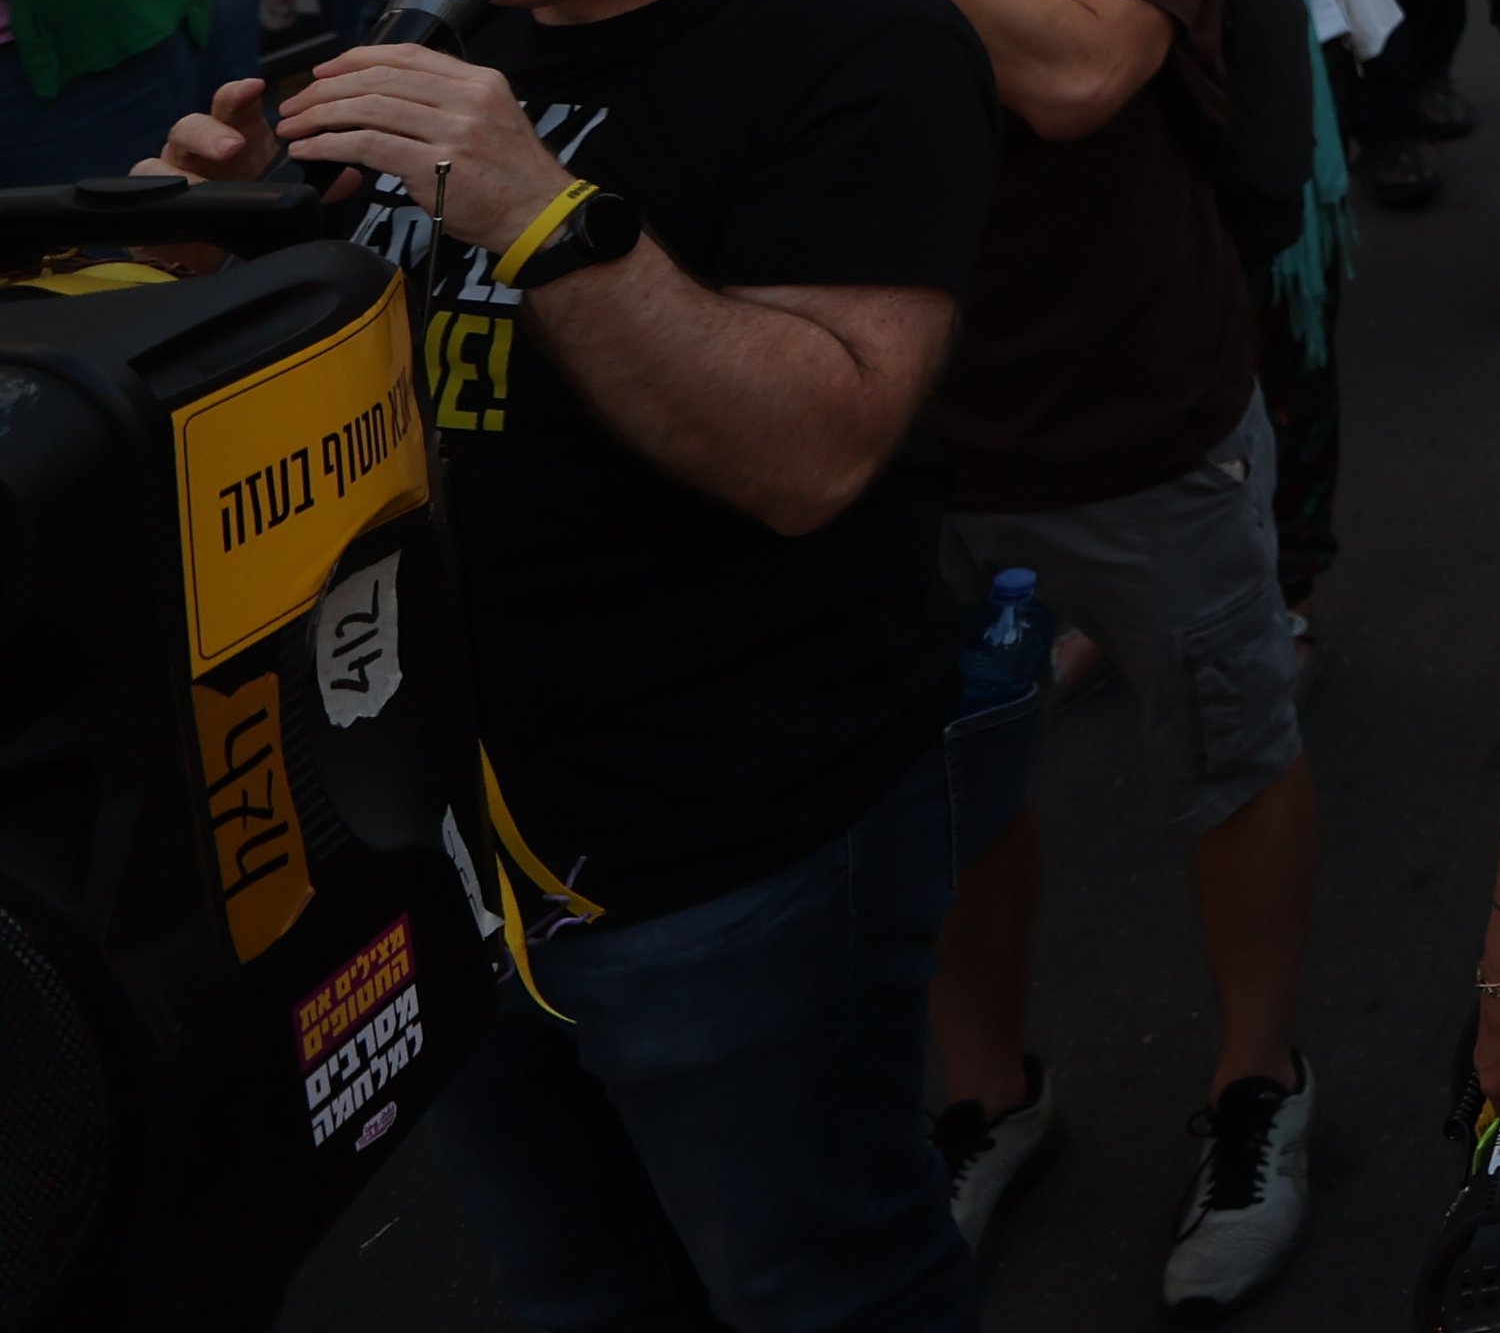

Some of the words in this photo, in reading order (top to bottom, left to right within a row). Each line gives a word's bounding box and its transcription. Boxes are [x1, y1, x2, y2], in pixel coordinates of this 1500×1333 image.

[219, 445, 316, 553] בעזה
[323, 401, 389, 499] חטוף
[299, 986, 332, 1033] את
[303, 948, 411, 1062] החטופים
[334, 924, 406, 995] מצילים
[305, 982, 420, 1112] מסרבים
[311, 1020, 424, 1149] למלחמה
